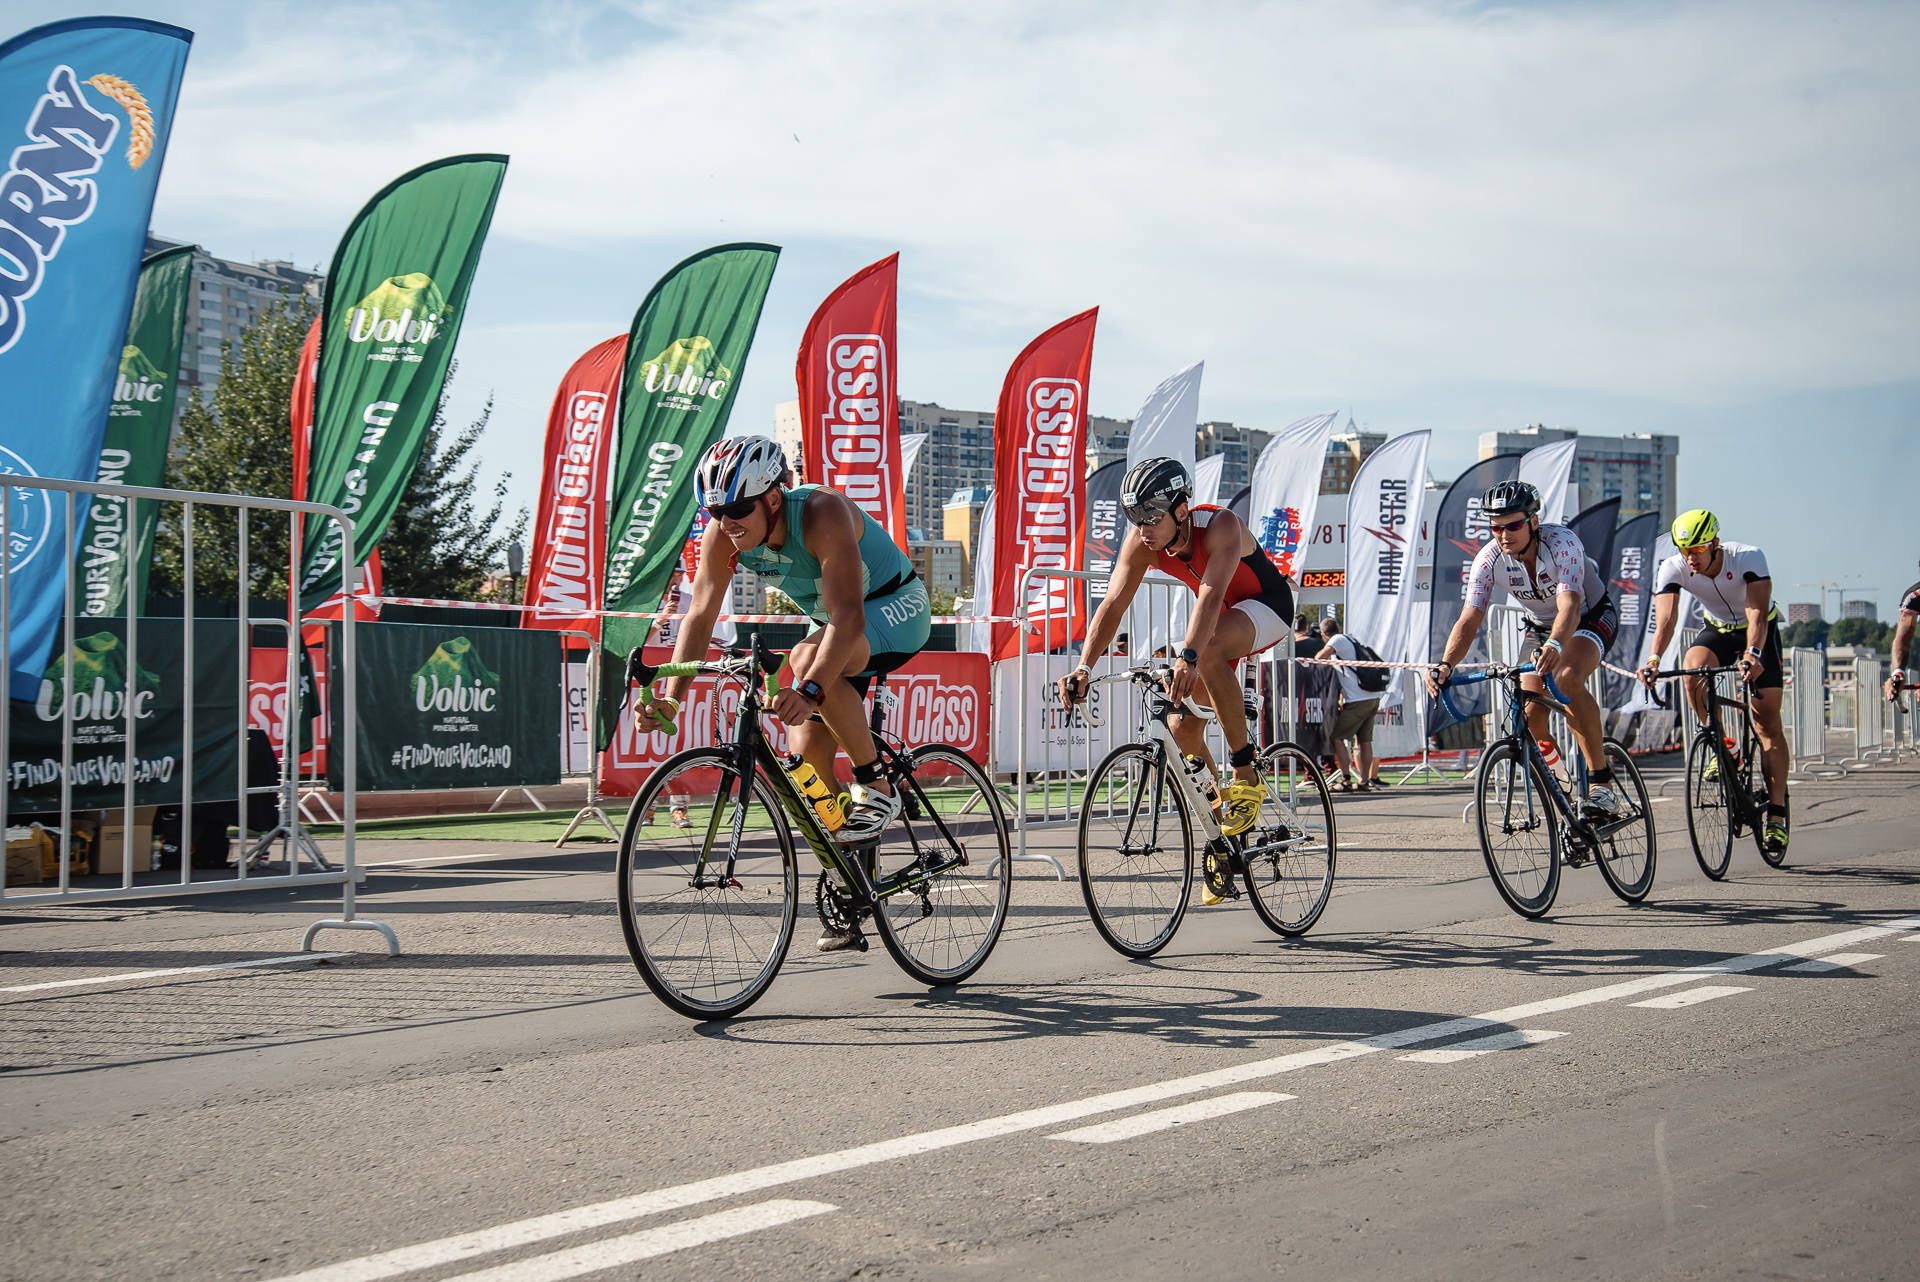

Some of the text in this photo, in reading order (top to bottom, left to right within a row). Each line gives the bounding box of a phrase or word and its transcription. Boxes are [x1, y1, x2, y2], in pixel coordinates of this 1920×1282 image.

[113, 373, 164, 403] lvic
[645, 362, 726, 400] Volvic
[832, 345, 881, 464] Class
[559, 398, 603, 498] Class
[1025, 387, 1075, 616] World Class
[1090, 499, 1117, 598] IRN STAR
[1273, 520, 1289, 575] TNESS
[1377, 479, 1407, 595] IRON STAR
[1620, 546, 1642, 626] IRON STAR
[659, 619, 670, 644] TEA
[414, 674, 497, 712] Volvic
[885, 694, 896, 708] 431
[907, 685, 973, 744] Class
[391, 742, 512, 770] #FINDYOURVOLCANO
[730, 802, 745, 860] MERIDA
